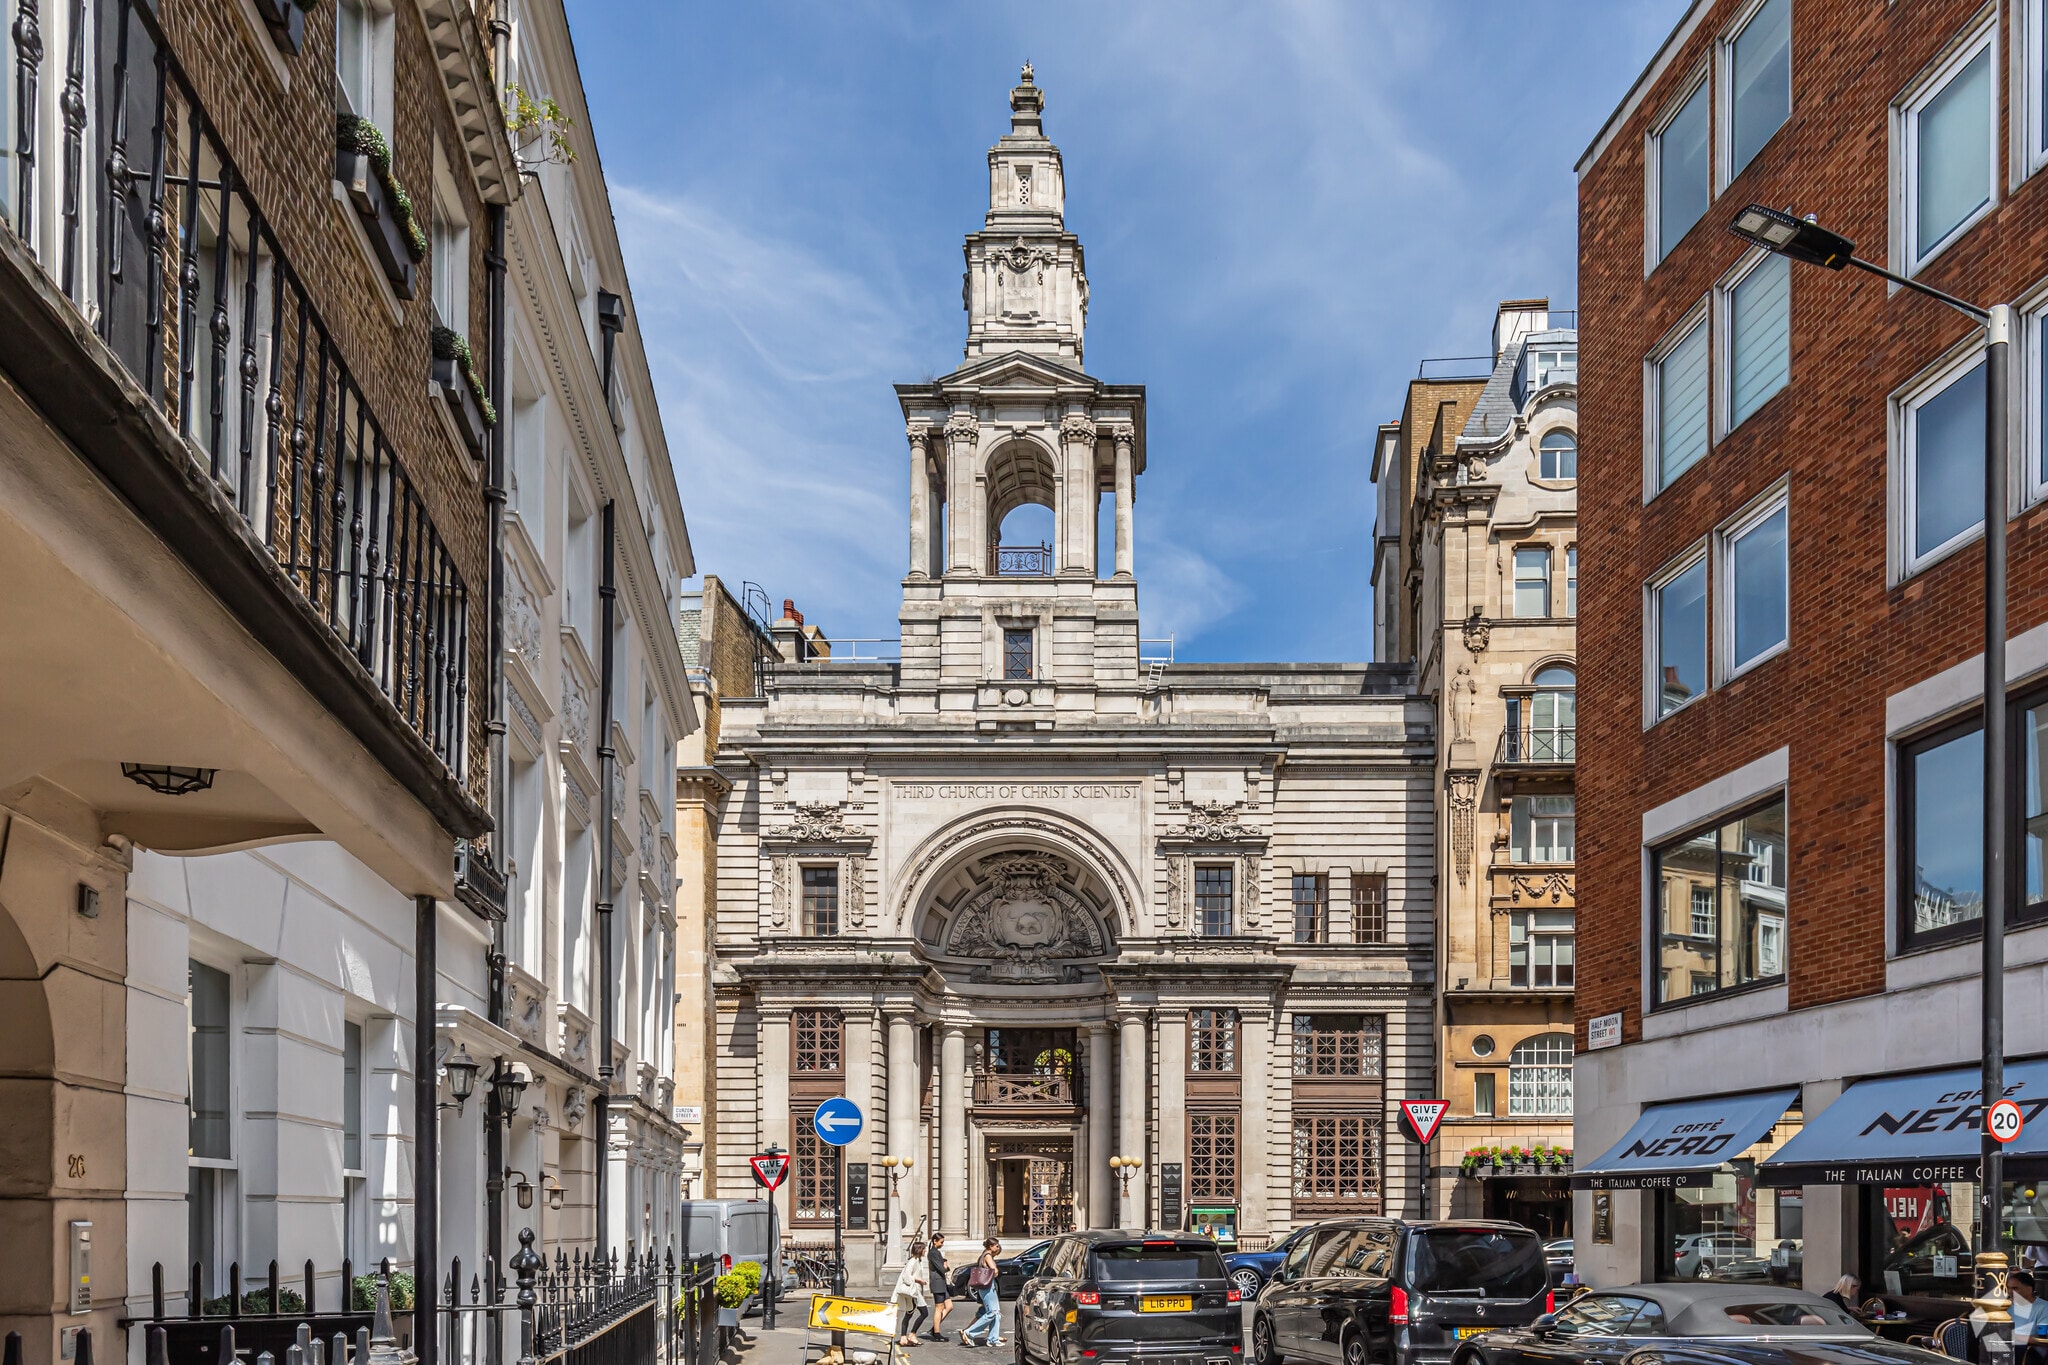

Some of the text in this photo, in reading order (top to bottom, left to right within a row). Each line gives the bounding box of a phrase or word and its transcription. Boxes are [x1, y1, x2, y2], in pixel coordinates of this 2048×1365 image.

[894, 786, 1140, 799] THIRD CHURCH OF CHRIST SCIENTIST
[1049, 887, 1101, 945] RAISE THE DEAD
[994, 966, 1016, 975] HEAL
[1020, 966, 1035, 975] THE
[1591, 1016, 1619, 1030] HALF MOON
[1591, 1027, 1616, 1040] STREET W1
[1411, 1105, 1438, 1114] GIVE
[1993, 1112, 2018, 1130] 20
[1618, 1133, 1737, 1159] NERO
[68, 1153, 86, 1178] 26
[758, 1160, 782, 1168] GIVE
[1825, 1170, 1846, 1182] THE
[1856, 1168, 1903, 1181] ITALIAN
[1912, 1166, 1965, 1180] COFFEE
[1590, 1178, 1603, 1188] THE
[1608, 1178, 1636, 1188] ITALIAN
[1640, 1177, 1671, 1188] COFFEE
[854, 1186, 861, 1195] 7
[1150, 1299, 1165, 1309] L16
